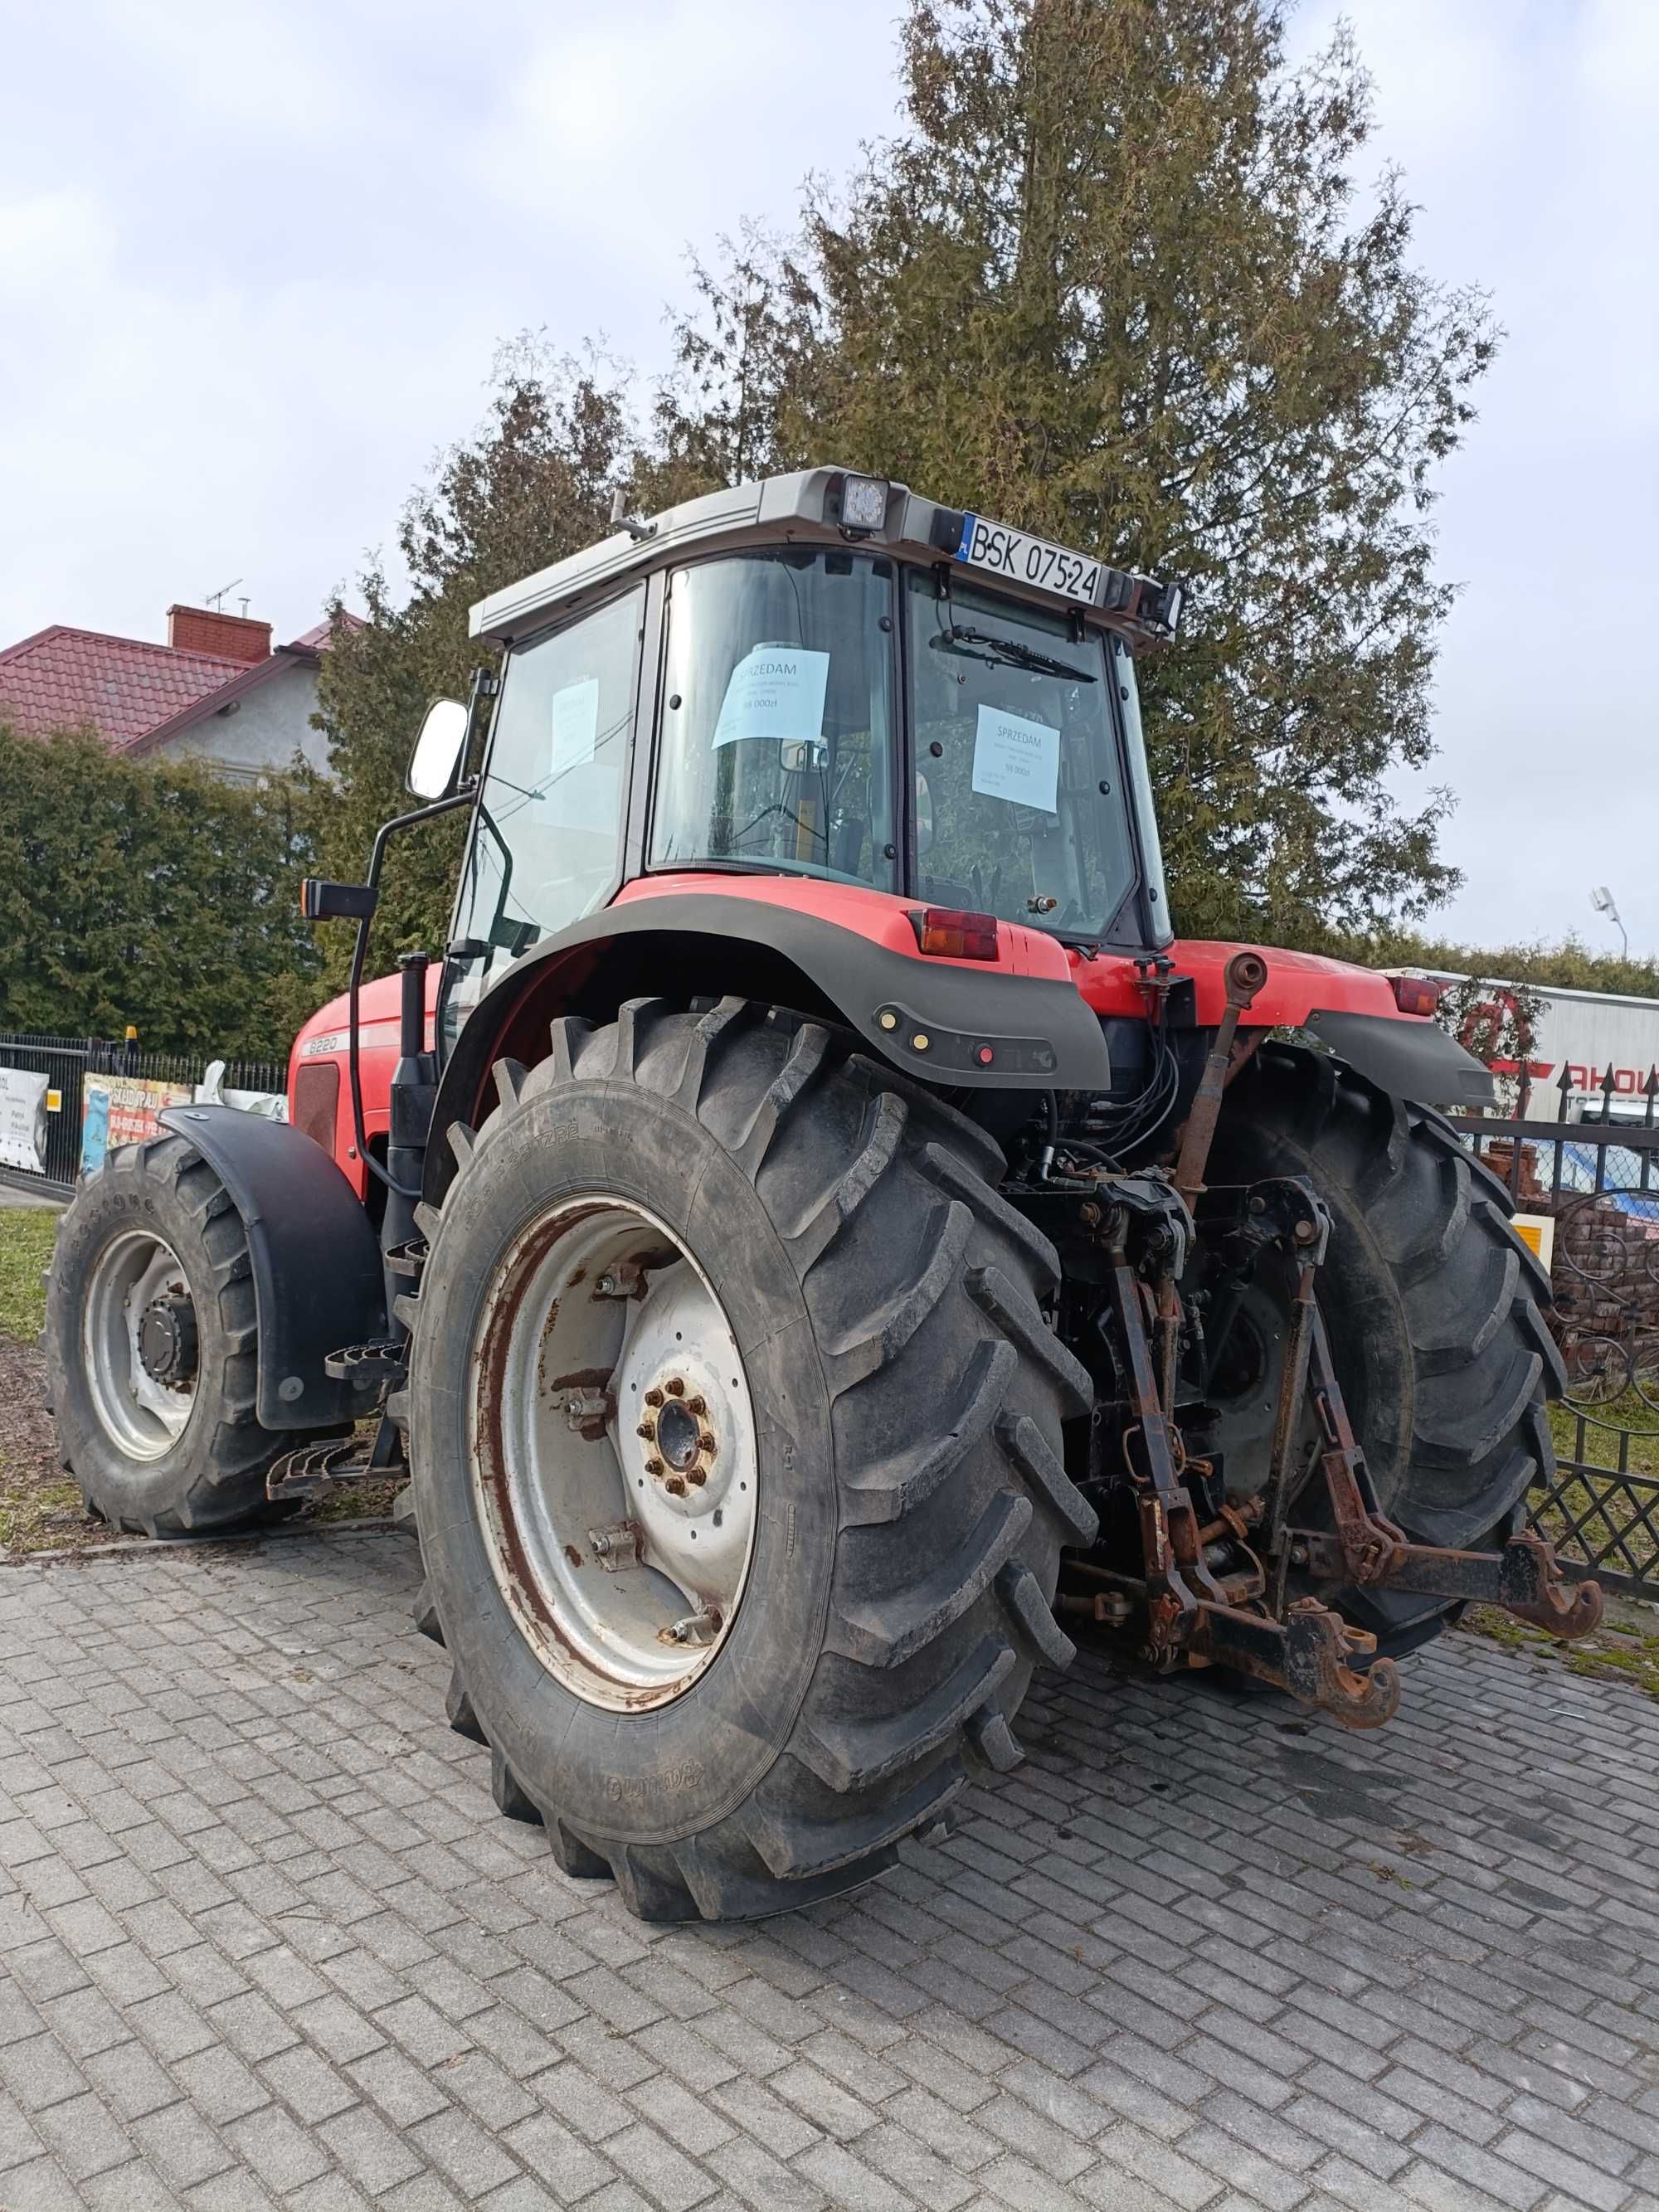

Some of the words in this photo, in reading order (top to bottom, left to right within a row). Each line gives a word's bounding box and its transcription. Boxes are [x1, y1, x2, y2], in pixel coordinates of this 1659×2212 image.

[971, 523, 1022, 574] BSK
[1025, 545, 1098, 600] 07524
[996, 725, 1042, 749] SPRZEDAM
